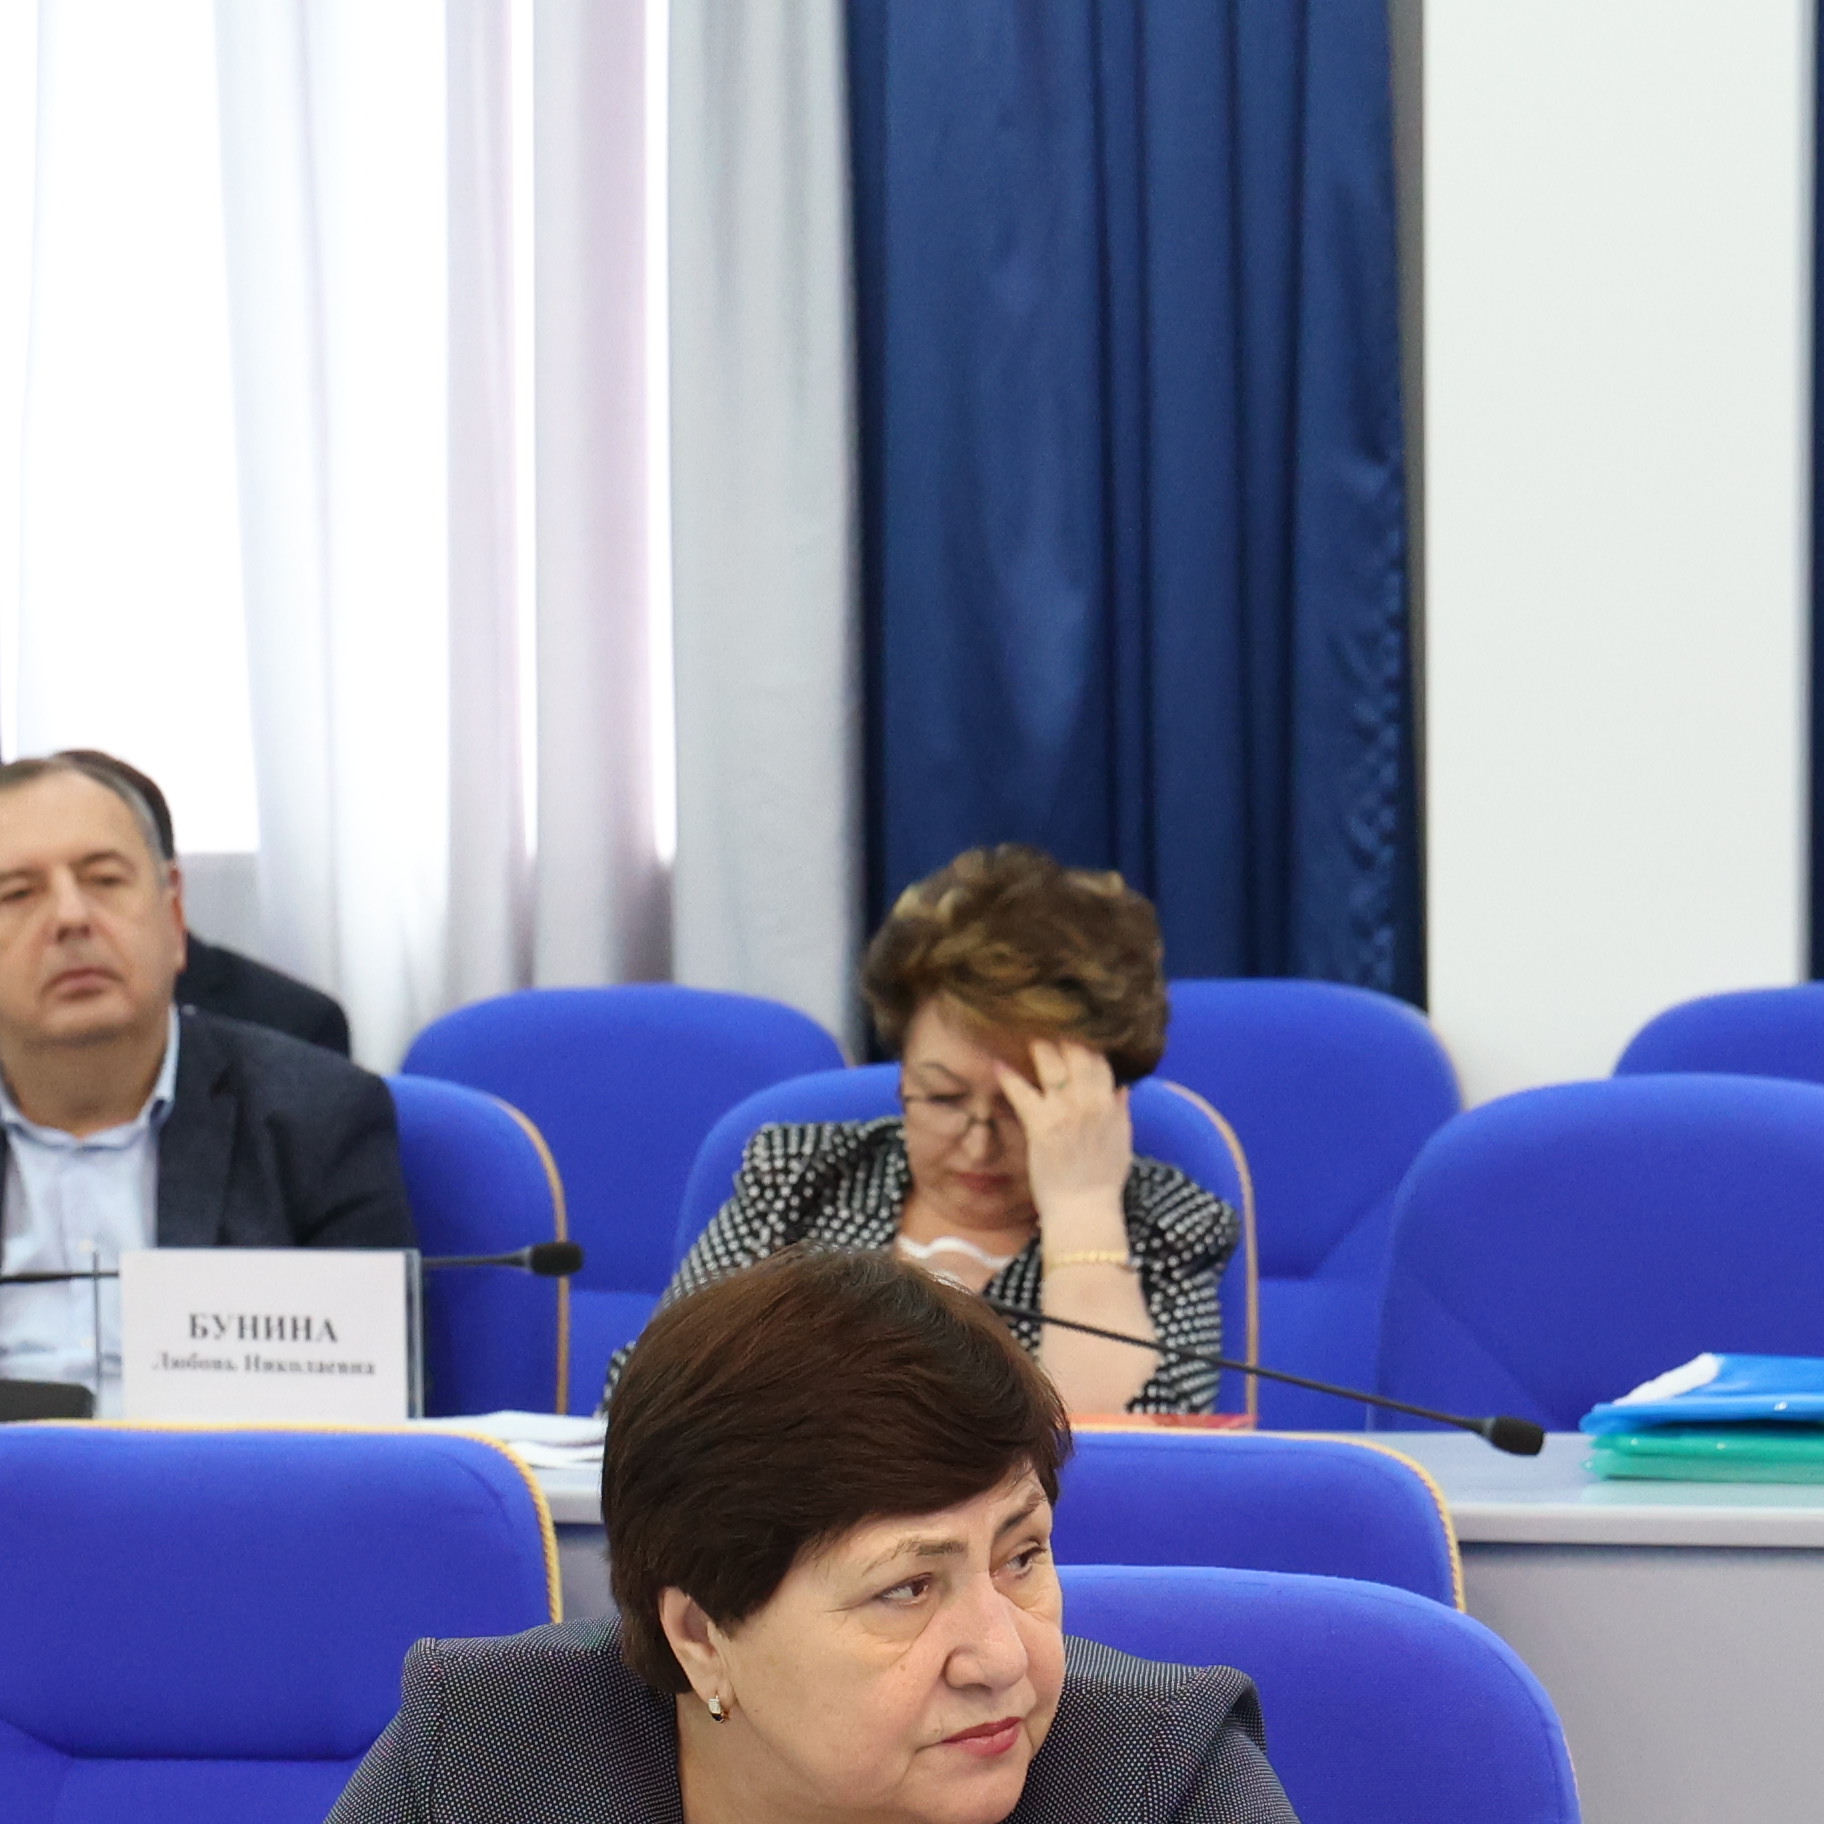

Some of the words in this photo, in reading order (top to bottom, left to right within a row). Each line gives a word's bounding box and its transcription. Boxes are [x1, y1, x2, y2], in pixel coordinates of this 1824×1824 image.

[188, 1312, 339, 1344] БУНИНА
[150, 1351, 238, 1374] Любовь
[242, 1352, 377, 1376] Николаевна
